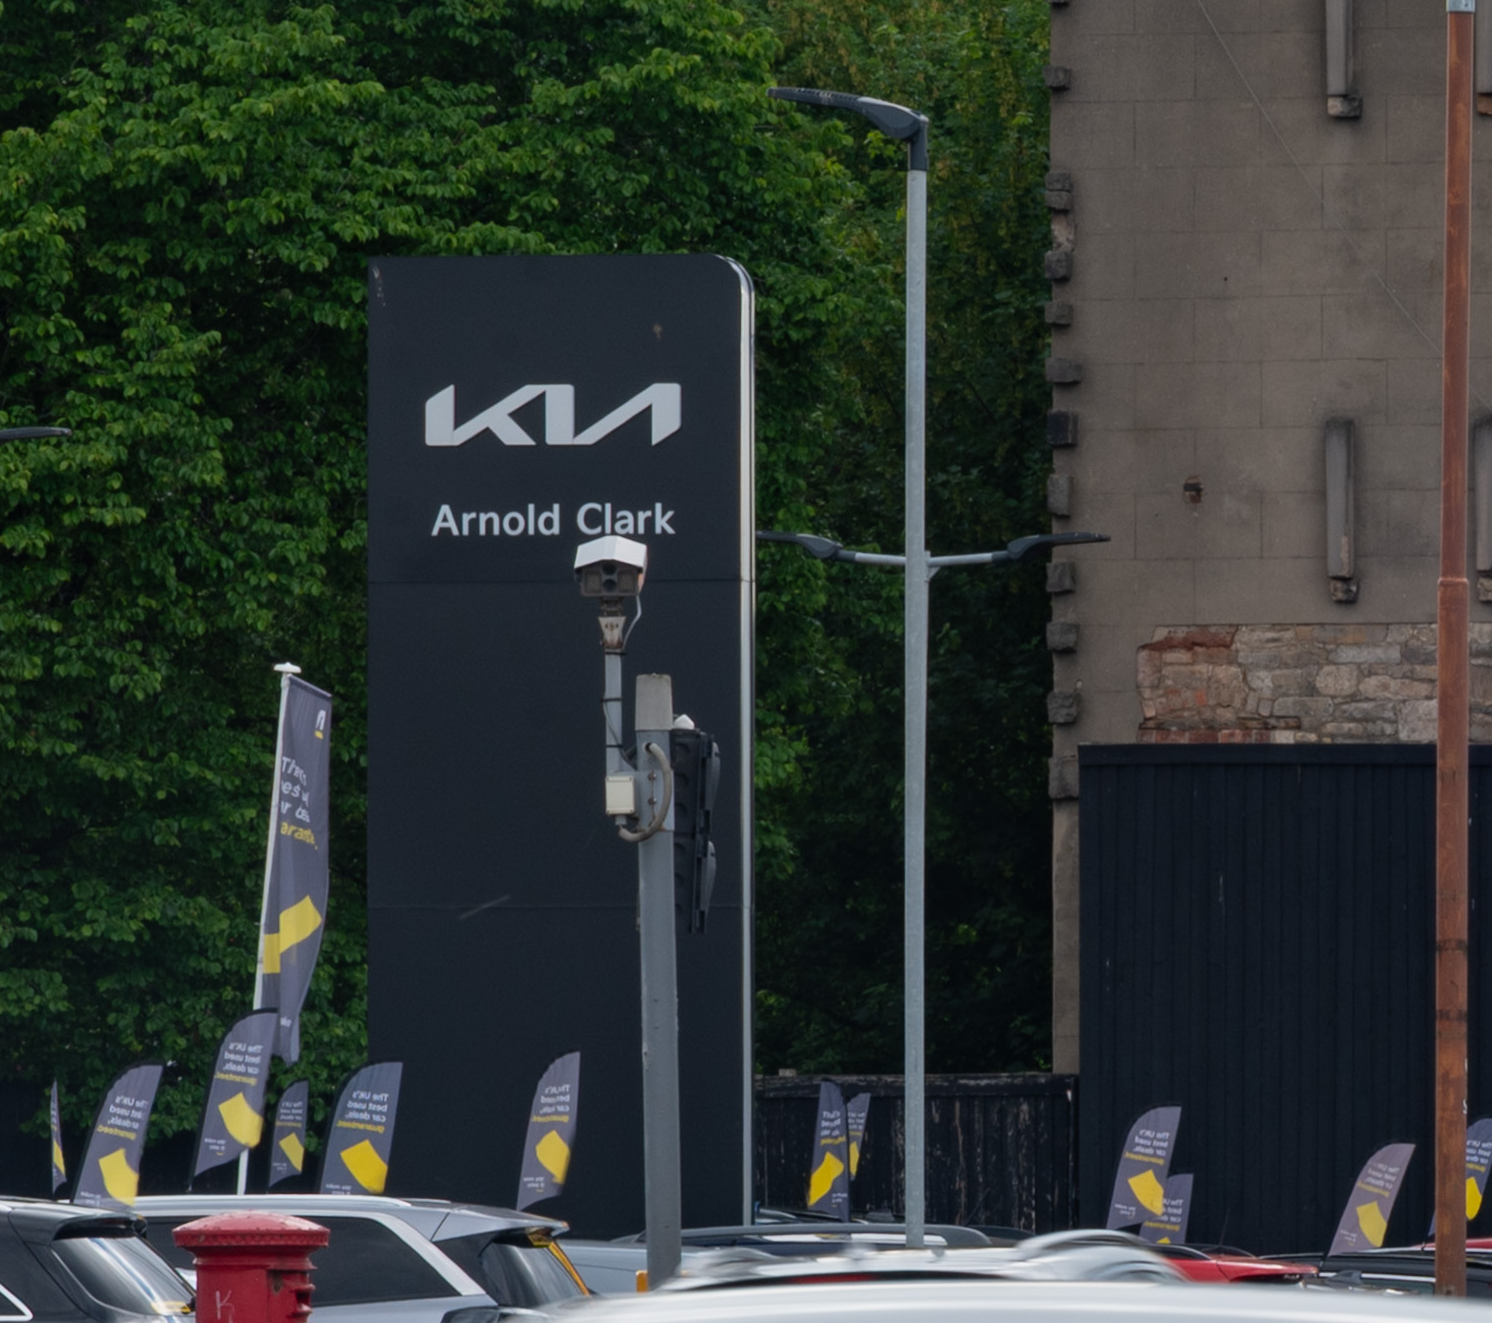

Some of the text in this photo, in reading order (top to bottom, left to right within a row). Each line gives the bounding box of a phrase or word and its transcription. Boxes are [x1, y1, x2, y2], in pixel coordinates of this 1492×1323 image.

[425, 383, 681, 446] KIA
[431, 502, 677, 536] Arnold Clark
